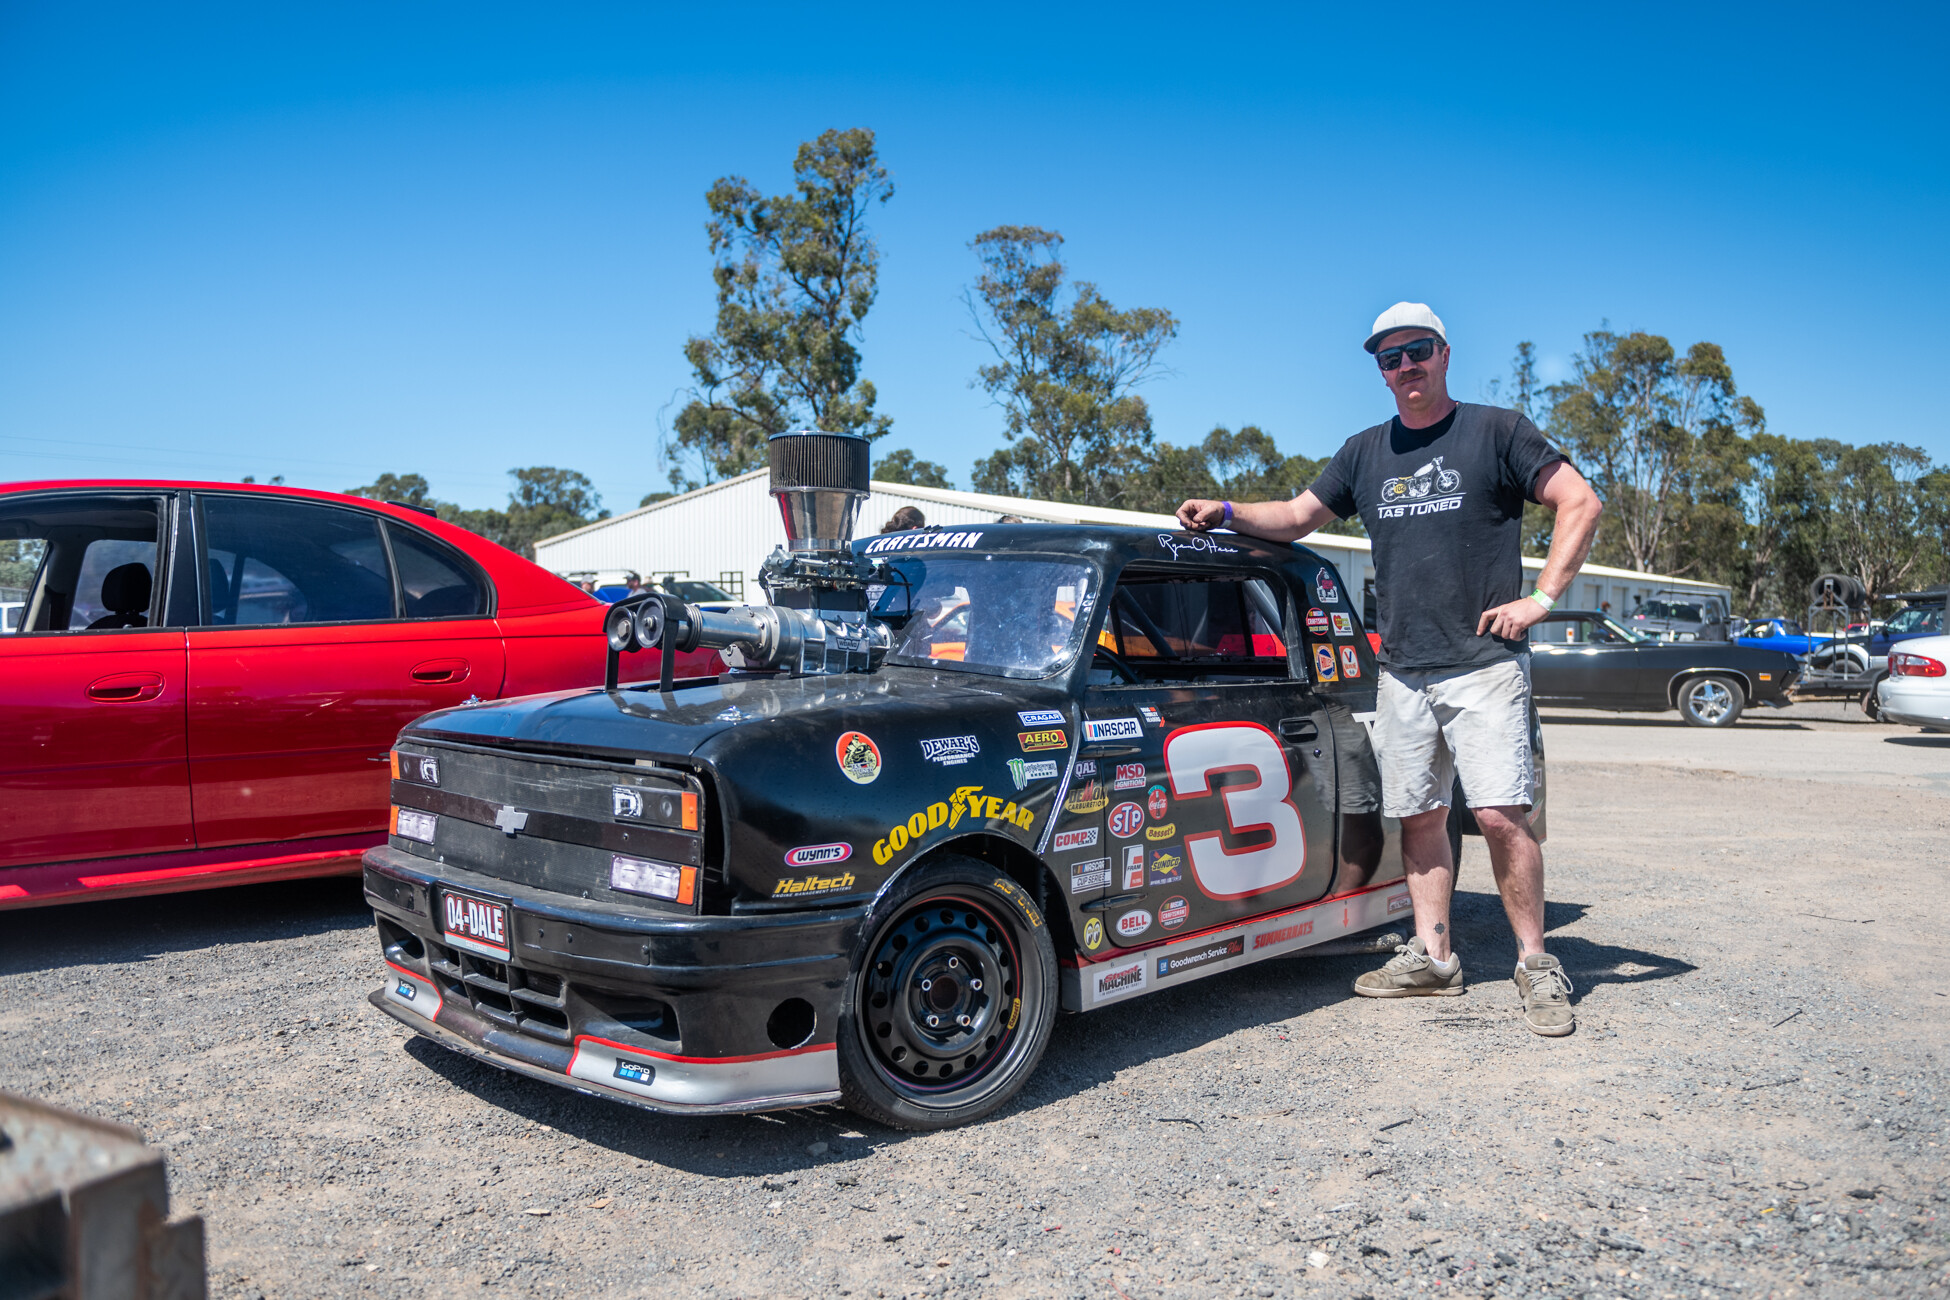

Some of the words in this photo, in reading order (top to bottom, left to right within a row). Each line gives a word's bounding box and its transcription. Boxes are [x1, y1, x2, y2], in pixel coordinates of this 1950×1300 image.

[1377, 505, 1408, 519] TAS
[1408, 497, 1462, 516] TUNED
[865, 532, 984, 554] CRAFTSMAN
[1024, 713, 1061, 722] CRAGAR
[1099, 721, 1138, 737] NASCAR
[1024, 732, 1059, 743] AERO
[920, 735, 980, 760] DEWAR'S
[932, 753, 975, 762] PERFORMANCE
[1075, 761, 1096, 778] QA1
[1116, 763, 1145, 780] MSD
[1117, 779, 1144, 789] IGNITION
[1163, 721, 1307, 901] 3
[1112, 805, 1141, 834] STP
[1056, 831, 1087, 847] COMP
[1153, 858, 1180, 870] SUNOCO
[774, 872, 856, 894] Haltech
[1077, 876, 1088, 886] CUP
[1088, 872, 1105, 884] SERIES
[1162, 908, 1186, 919] CRAFTSMAN
[1121, 915, 1147, 930] BELL
[1170, 951, 1208, 969] Goodwrench
[1207, 946, 1228, 959] Service
[1098, 968, 1142, 993] MACHINE
[621, 1061, 650, 1075] GoPro
